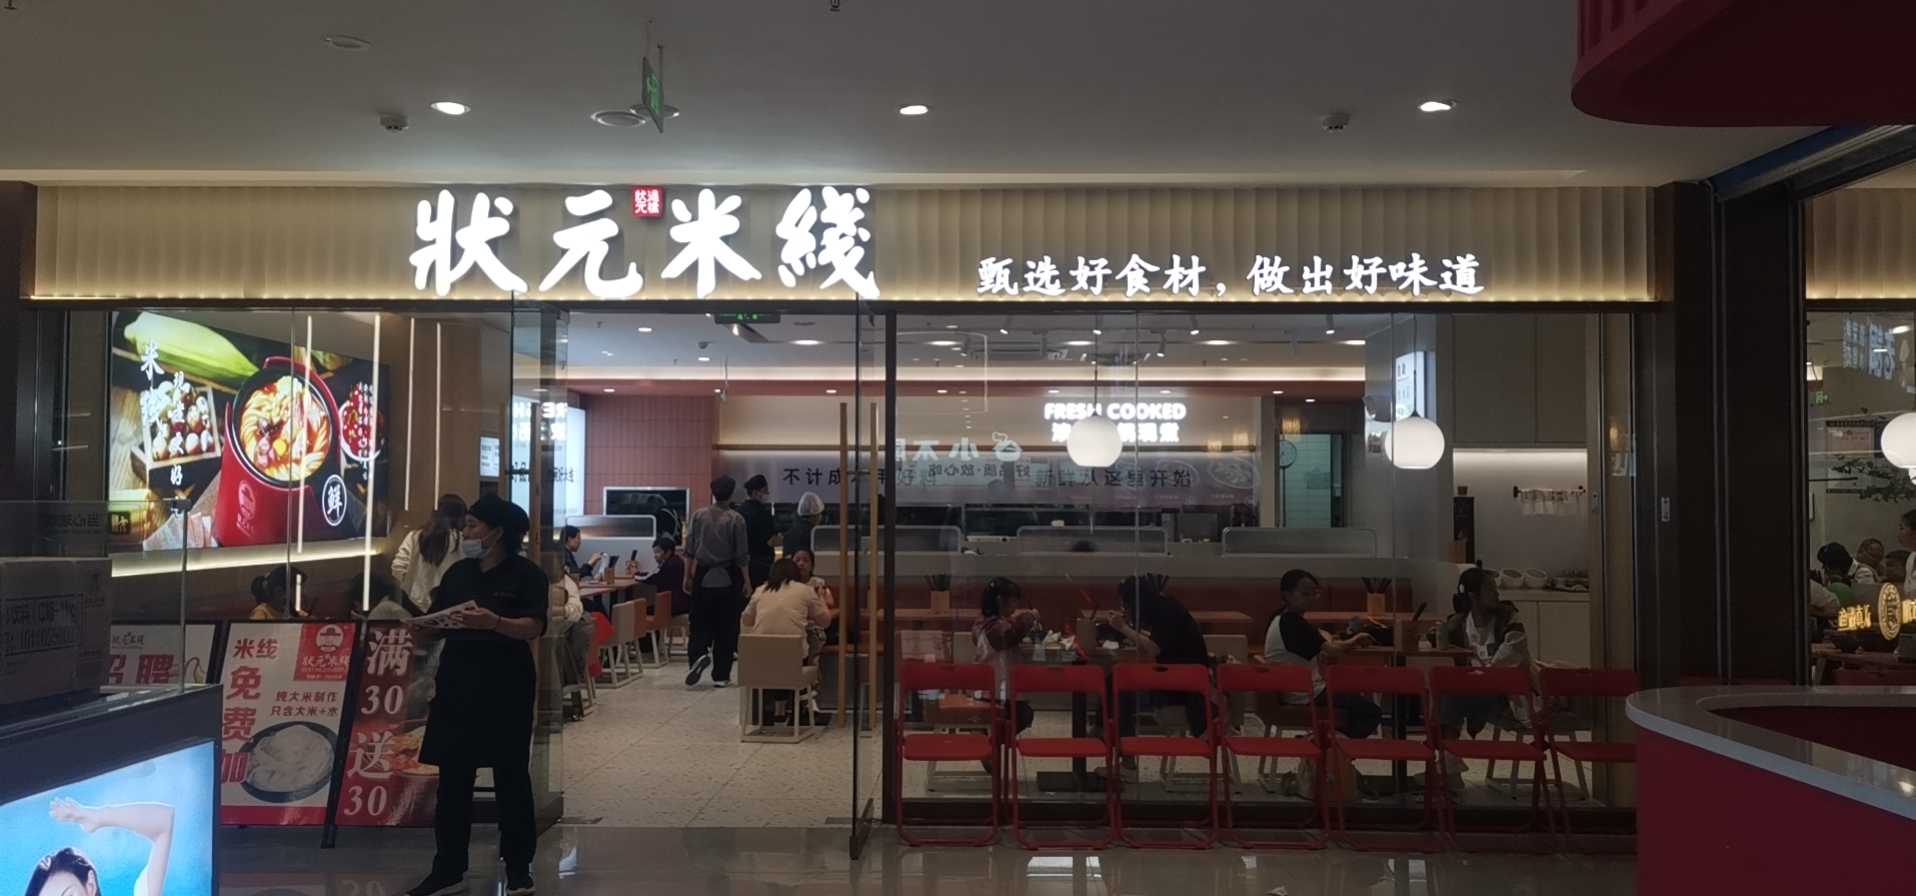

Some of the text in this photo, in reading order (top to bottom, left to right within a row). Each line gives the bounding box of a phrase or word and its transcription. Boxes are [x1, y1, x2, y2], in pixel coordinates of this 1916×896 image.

[1044, 402, 1187, 421] FRESH COOKED
[233, 638, 278, 659] 米线
[366, 628, 413, 676] 满
[275, 691, 338, 703] 纯大米制作
[361, 685, 403, 715] 30
[270, 706, 338, 717] 只含大米+水
[347, 731, 396, 780] 送
[343, 785, 387, 816] 30
